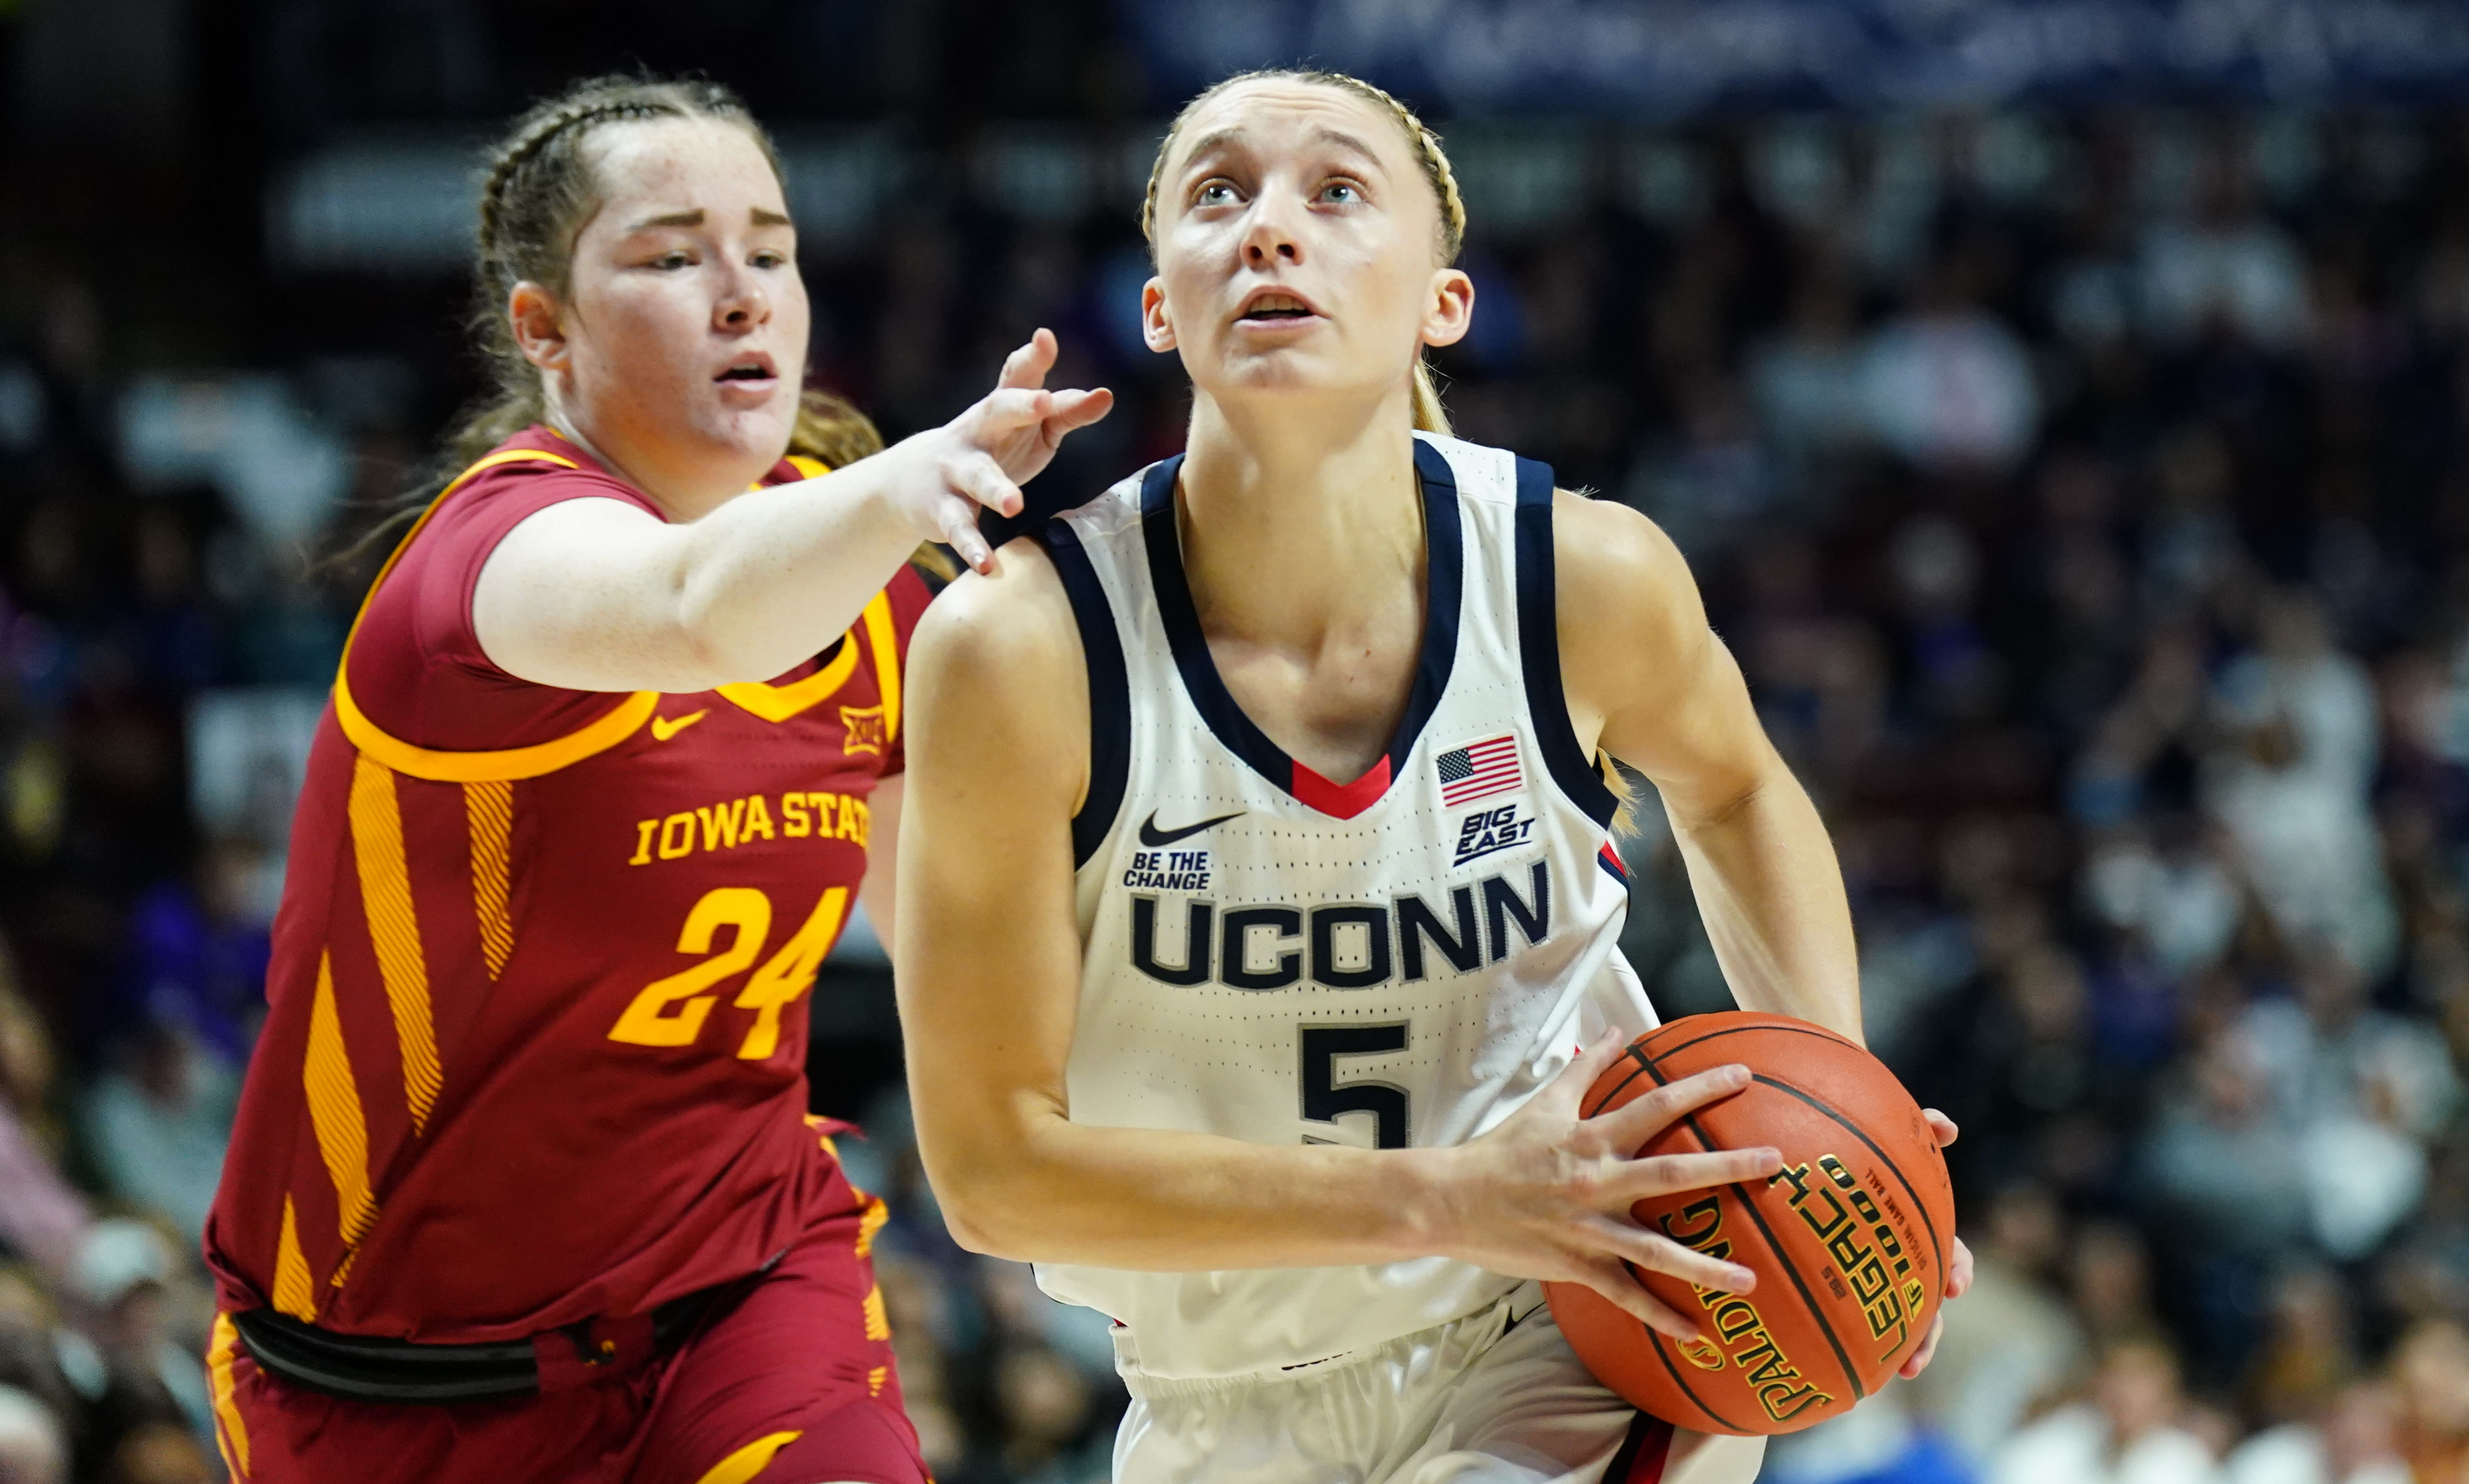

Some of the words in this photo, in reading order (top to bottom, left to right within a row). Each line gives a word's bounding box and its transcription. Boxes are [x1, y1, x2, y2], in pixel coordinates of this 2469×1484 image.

[628, 794, 776, 865] IOWA
[782, 791, 871, 851] STAT
[1455, 817, 1536, 856] EAST
[1461, 803, 1517, 836] BIG
[1122, 869, 1211, 890] CHANGE
[1132, 851, 1161, 871] BE
[1168, 851, 1209, 871] THE
[1130, 856, 1551, 993] UCONN
[607, 887, 849, 1060] 24
[1298, 1018, 1411, 1150] 5
[1865, 1168, 1886, 1197] BALL
[1883, 1194, 1906, 1226] GAME
[1817, 1153, 1914, 1281] 1000
[1767, 1162, 1908, 1365] LEGACY
